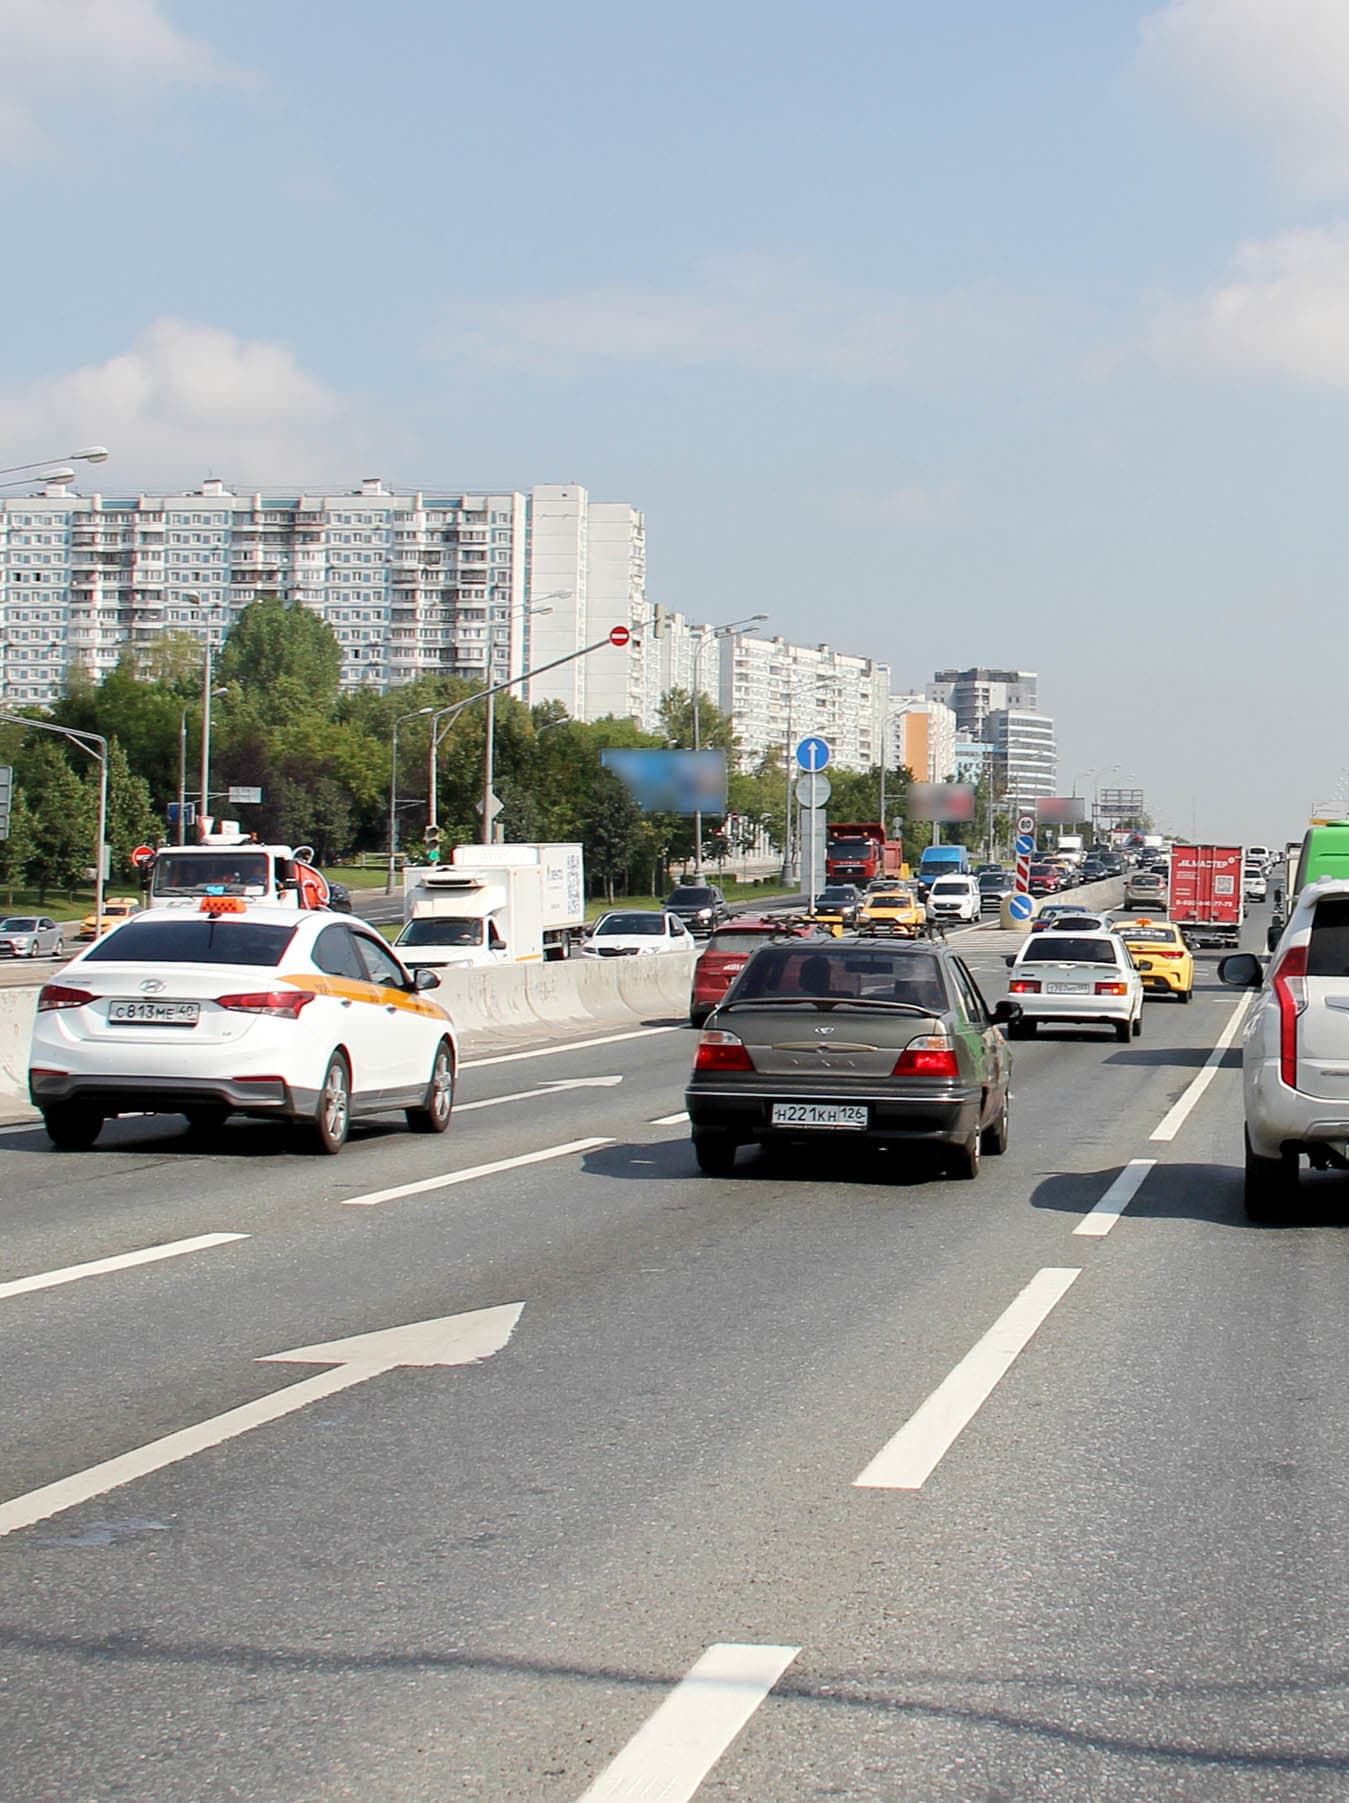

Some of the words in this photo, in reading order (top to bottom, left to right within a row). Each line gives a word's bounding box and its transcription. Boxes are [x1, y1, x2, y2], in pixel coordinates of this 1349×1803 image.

[116, 1004, 175, 1020] С813МЕ
[179, 1005, 195, 1017] 40
[777, 1106, 837, 1122] Н221КН
[840, 1107, 864, 1119] 126
